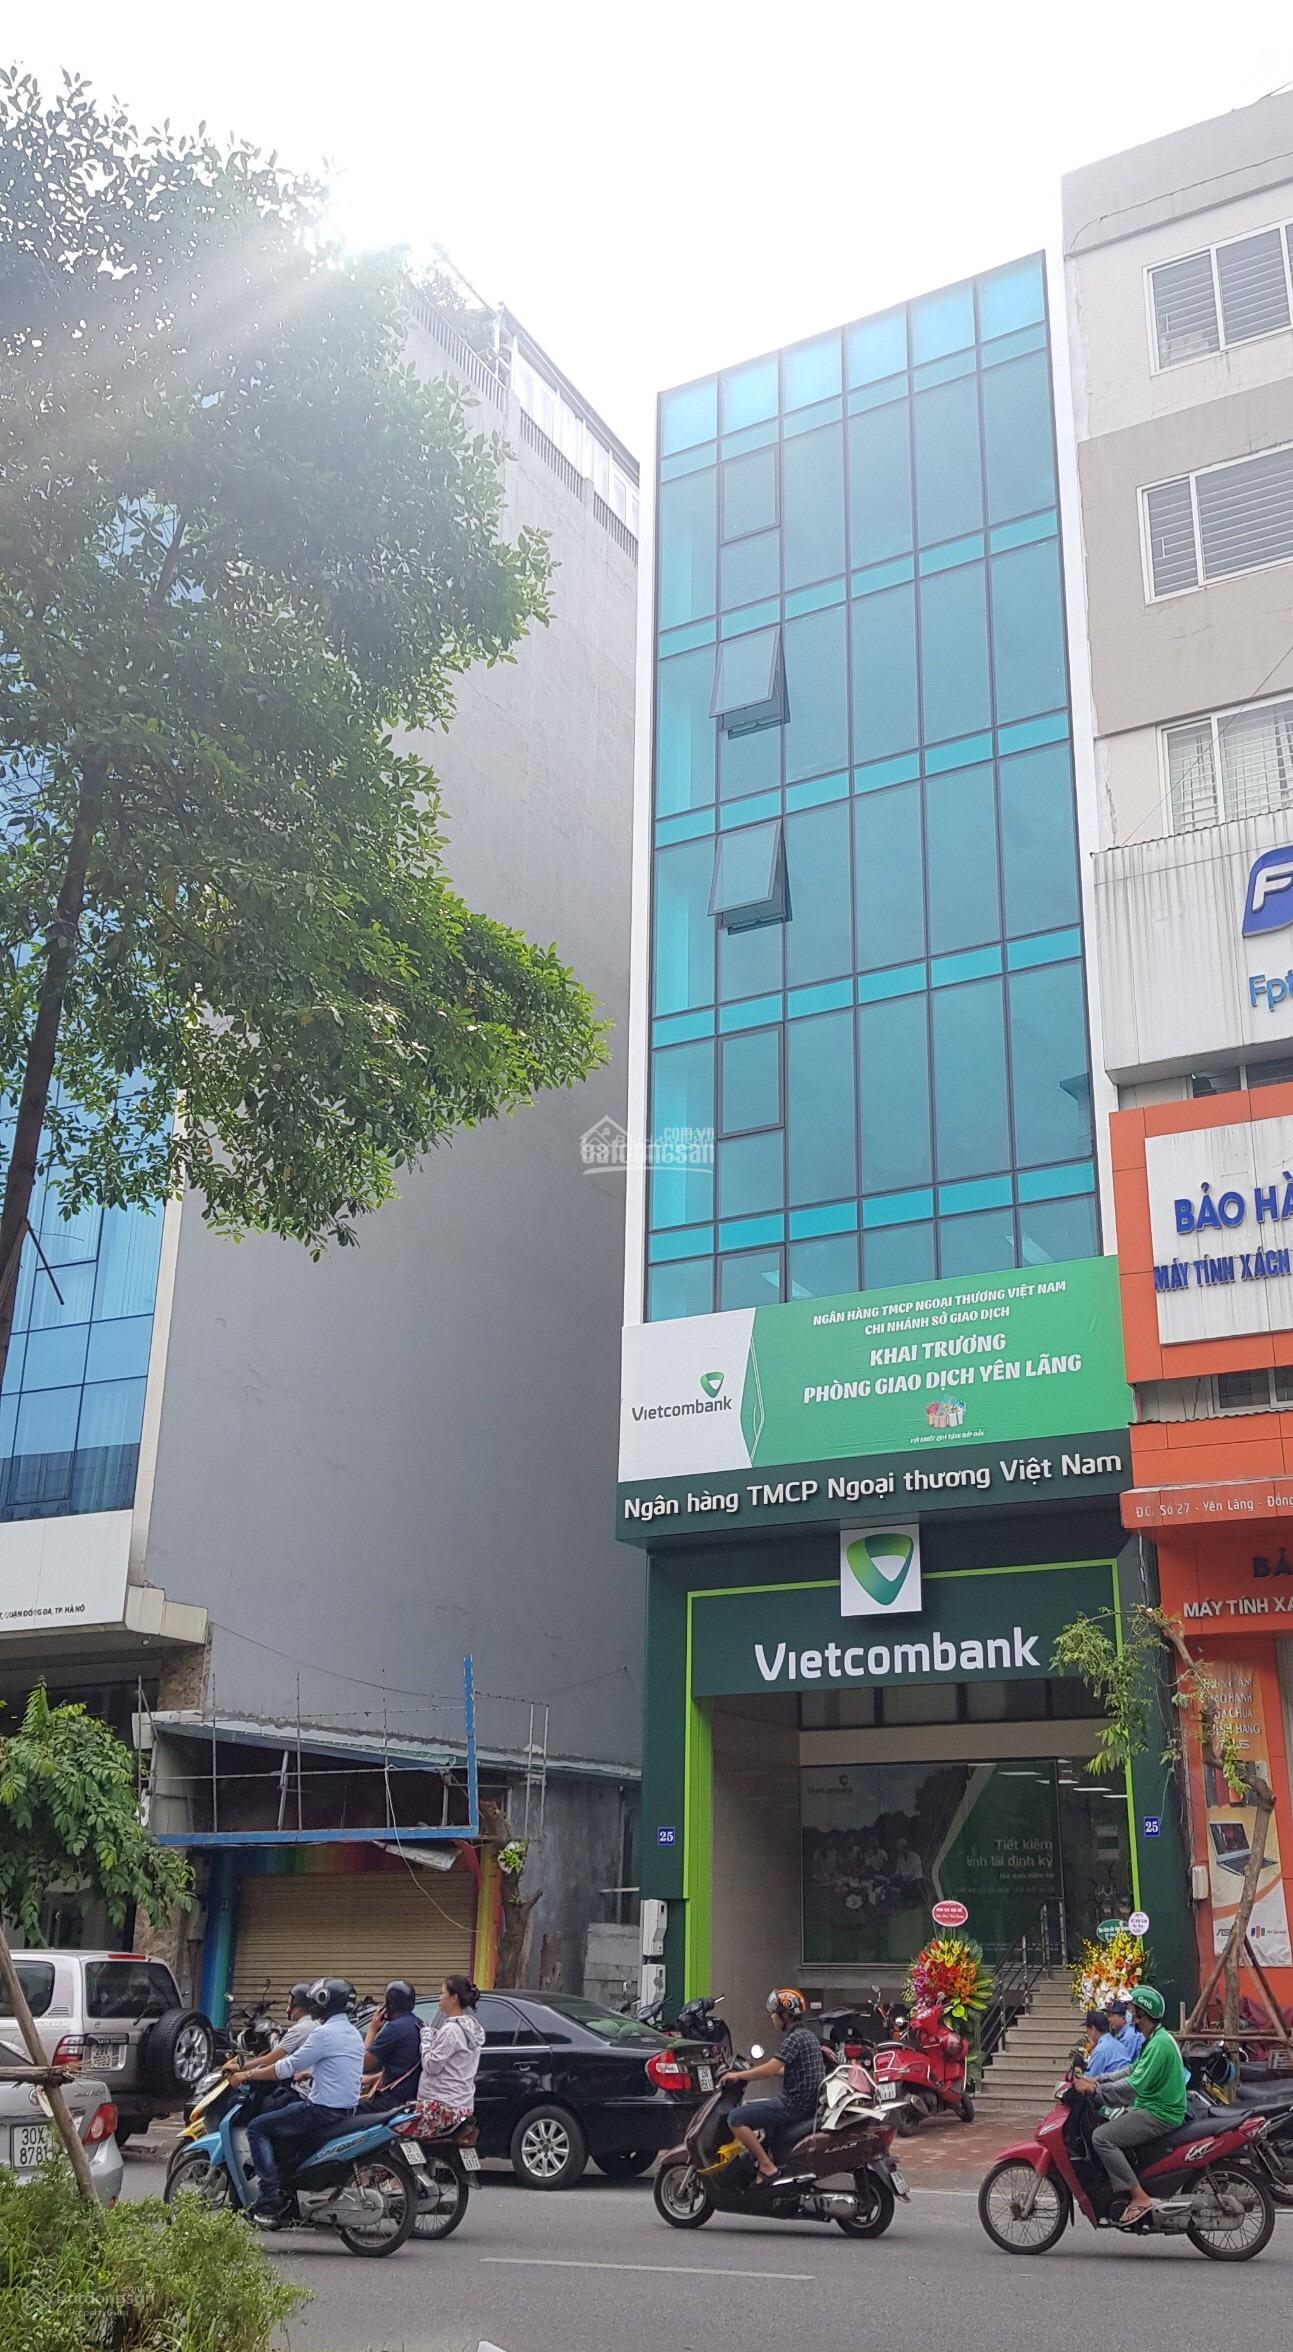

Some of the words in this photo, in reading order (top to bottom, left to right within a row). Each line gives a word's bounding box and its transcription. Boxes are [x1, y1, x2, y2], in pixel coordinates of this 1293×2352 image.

[1174, 1181, 1246, 1235] BẢO
[1153, 1257, 1190, 1293] MÁY
[1193, 1253, 1236, 1287] TÍNH
[1239, 1246, 1292, 1281] XÁCH
[813, 1310, 845, 1326] NGÂN
[847, 1306, 880, 1321] HÀNG
[881, 1302, 914, 1317] TMCP
[915, 1297, 952, 1312] NGOẠI
[955, 1290, 1006, 1306] THƯƠNG
[1007, 1284, 1036, 1300] VIỆT
[1037, 1280, 1066, 1295] NAM
[865, 1322, 885, 1336] CHI
[886, 1316, 929, 1332] NHÁNH
[930, 1312, 949, 1328] SỞ
[950, 1310, 979, 1324] GIAO
[980, 1306, 1010, 1321] DỊCH
[869, 1344, 918, 1367] KHAI
[921, 1333, 1007, 1360] TRƯƠNG
[803, 1379, 872, 1404] PHÒNG
[875, 1374, 921, 1395] GIAO
[925, 1367, 974, 1391] DỊCH
[978, 1360, 1020, 1382] YÊN
[1025, 1353, 1082, 1377] LÃNG
[631, 1395, 733, 1422] Vietcombank
[624, 1494, 679, 1522] Ngân
[687, 1490, 739, 1513] hàng
[746, 1480, 818, 1506] TMCP
[827, 1471, 895, 1501] Ngoại
[903, 1467, 991, 1492] thương
[999, 1456, 1052, 1486] Việt
[1061, 1453, 1122, 1477] Nam
[1177, 1503, 1190, 1515] 27
[1202, 1501, 1223, 1512] Yên
[1183, 1597, 1225, 1618] MÁY
[1226, 1595, 1269, 1615] TÍNH
[754, 1626, 1041, 1681] Vietcombank
[659, 1831, 674, 1842] 25
[1145, 1821, 1159, 1833] 25
